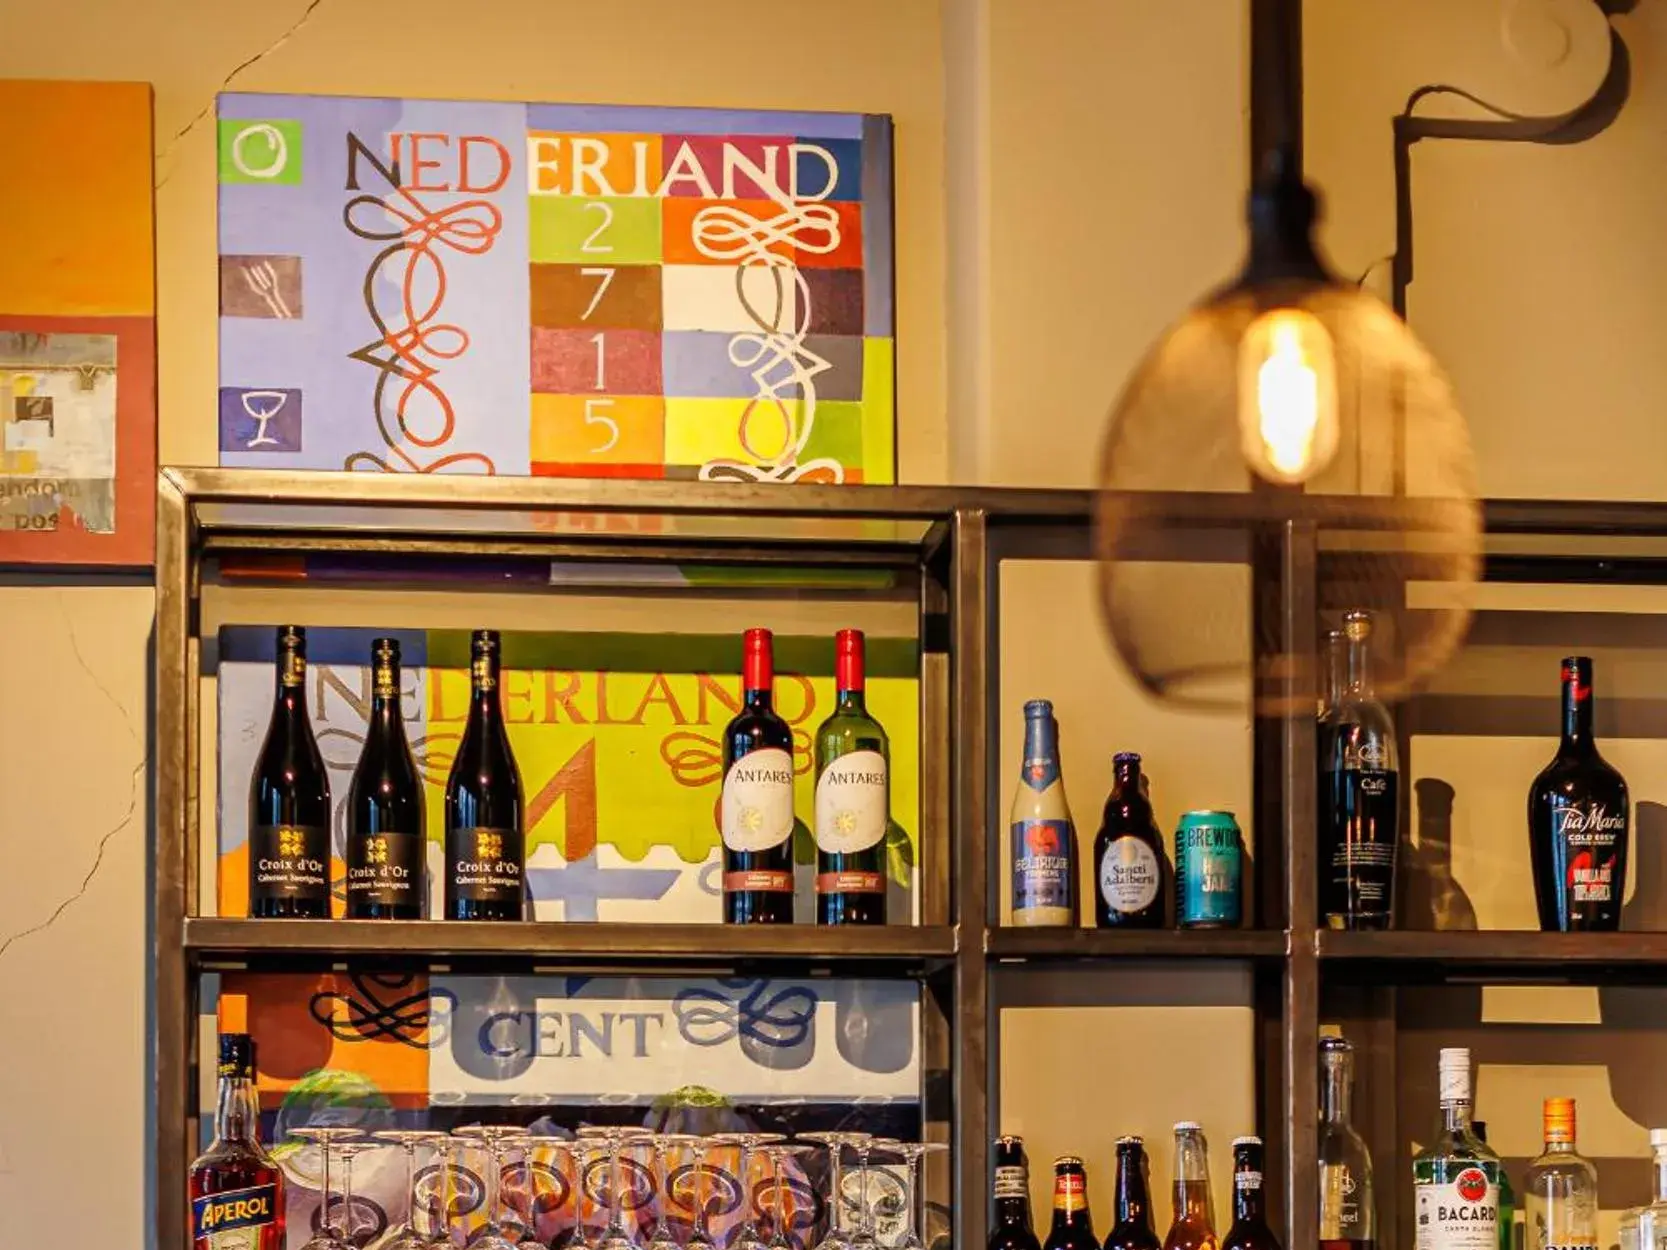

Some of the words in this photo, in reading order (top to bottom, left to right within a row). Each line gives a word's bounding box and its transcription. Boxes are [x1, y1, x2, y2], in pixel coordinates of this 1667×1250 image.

[580, 202, 613, 252] 2
[581, 268, 615, 320] 7
[588, 332, 606, 390] 1
[584, 400, 619, 453] 5
[735, 769, 791, 784] ANTARES
[828, 771, 885, 786] ANTARES
[259, 858, 292, 871] Croix
[457, 861, 491, 873] Croix
[477, 1011, 663, 1059] CENT
[201, 1197, 269, 1231] APEROL
[1438, 1206, 1497, 1221] BACARD
